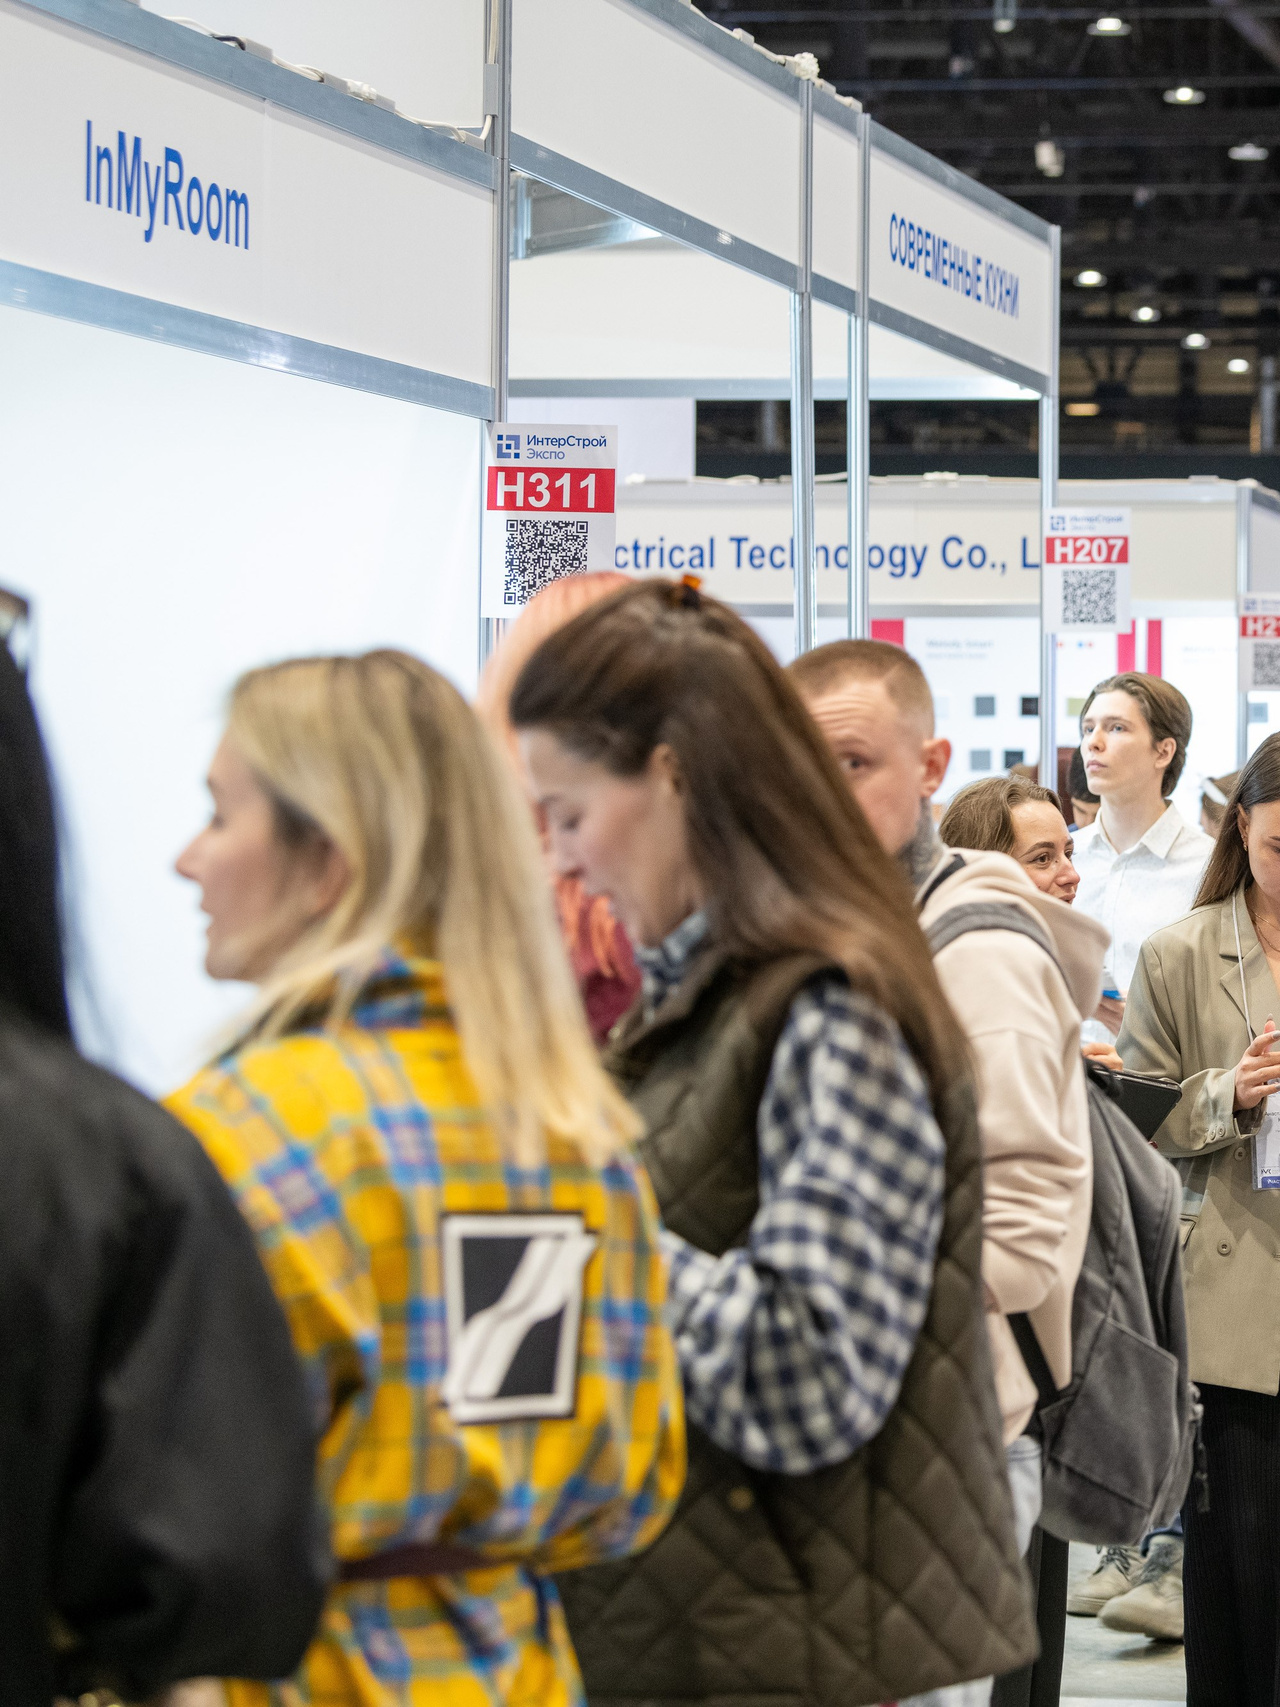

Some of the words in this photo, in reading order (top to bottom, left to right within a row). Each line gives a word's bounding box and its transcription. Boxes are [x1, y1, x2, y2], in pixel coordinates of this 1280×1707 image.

[86, 119, 250, 250] InMyRoom
[889, 212, 983, 303] СОВРЕМЕННЫЕ
[527, 434, 607, 449] ИнтерСтрой
[527, 448, 566, 460] Экспо
[497, 471, 596, 509] H311
[615, 536, 715, 569] ctrical
[729, 536, 927, 578] Tecnoogy
[941, 535, 1007, 577] Co.,
[1054, 538, 1125, 563] H207
